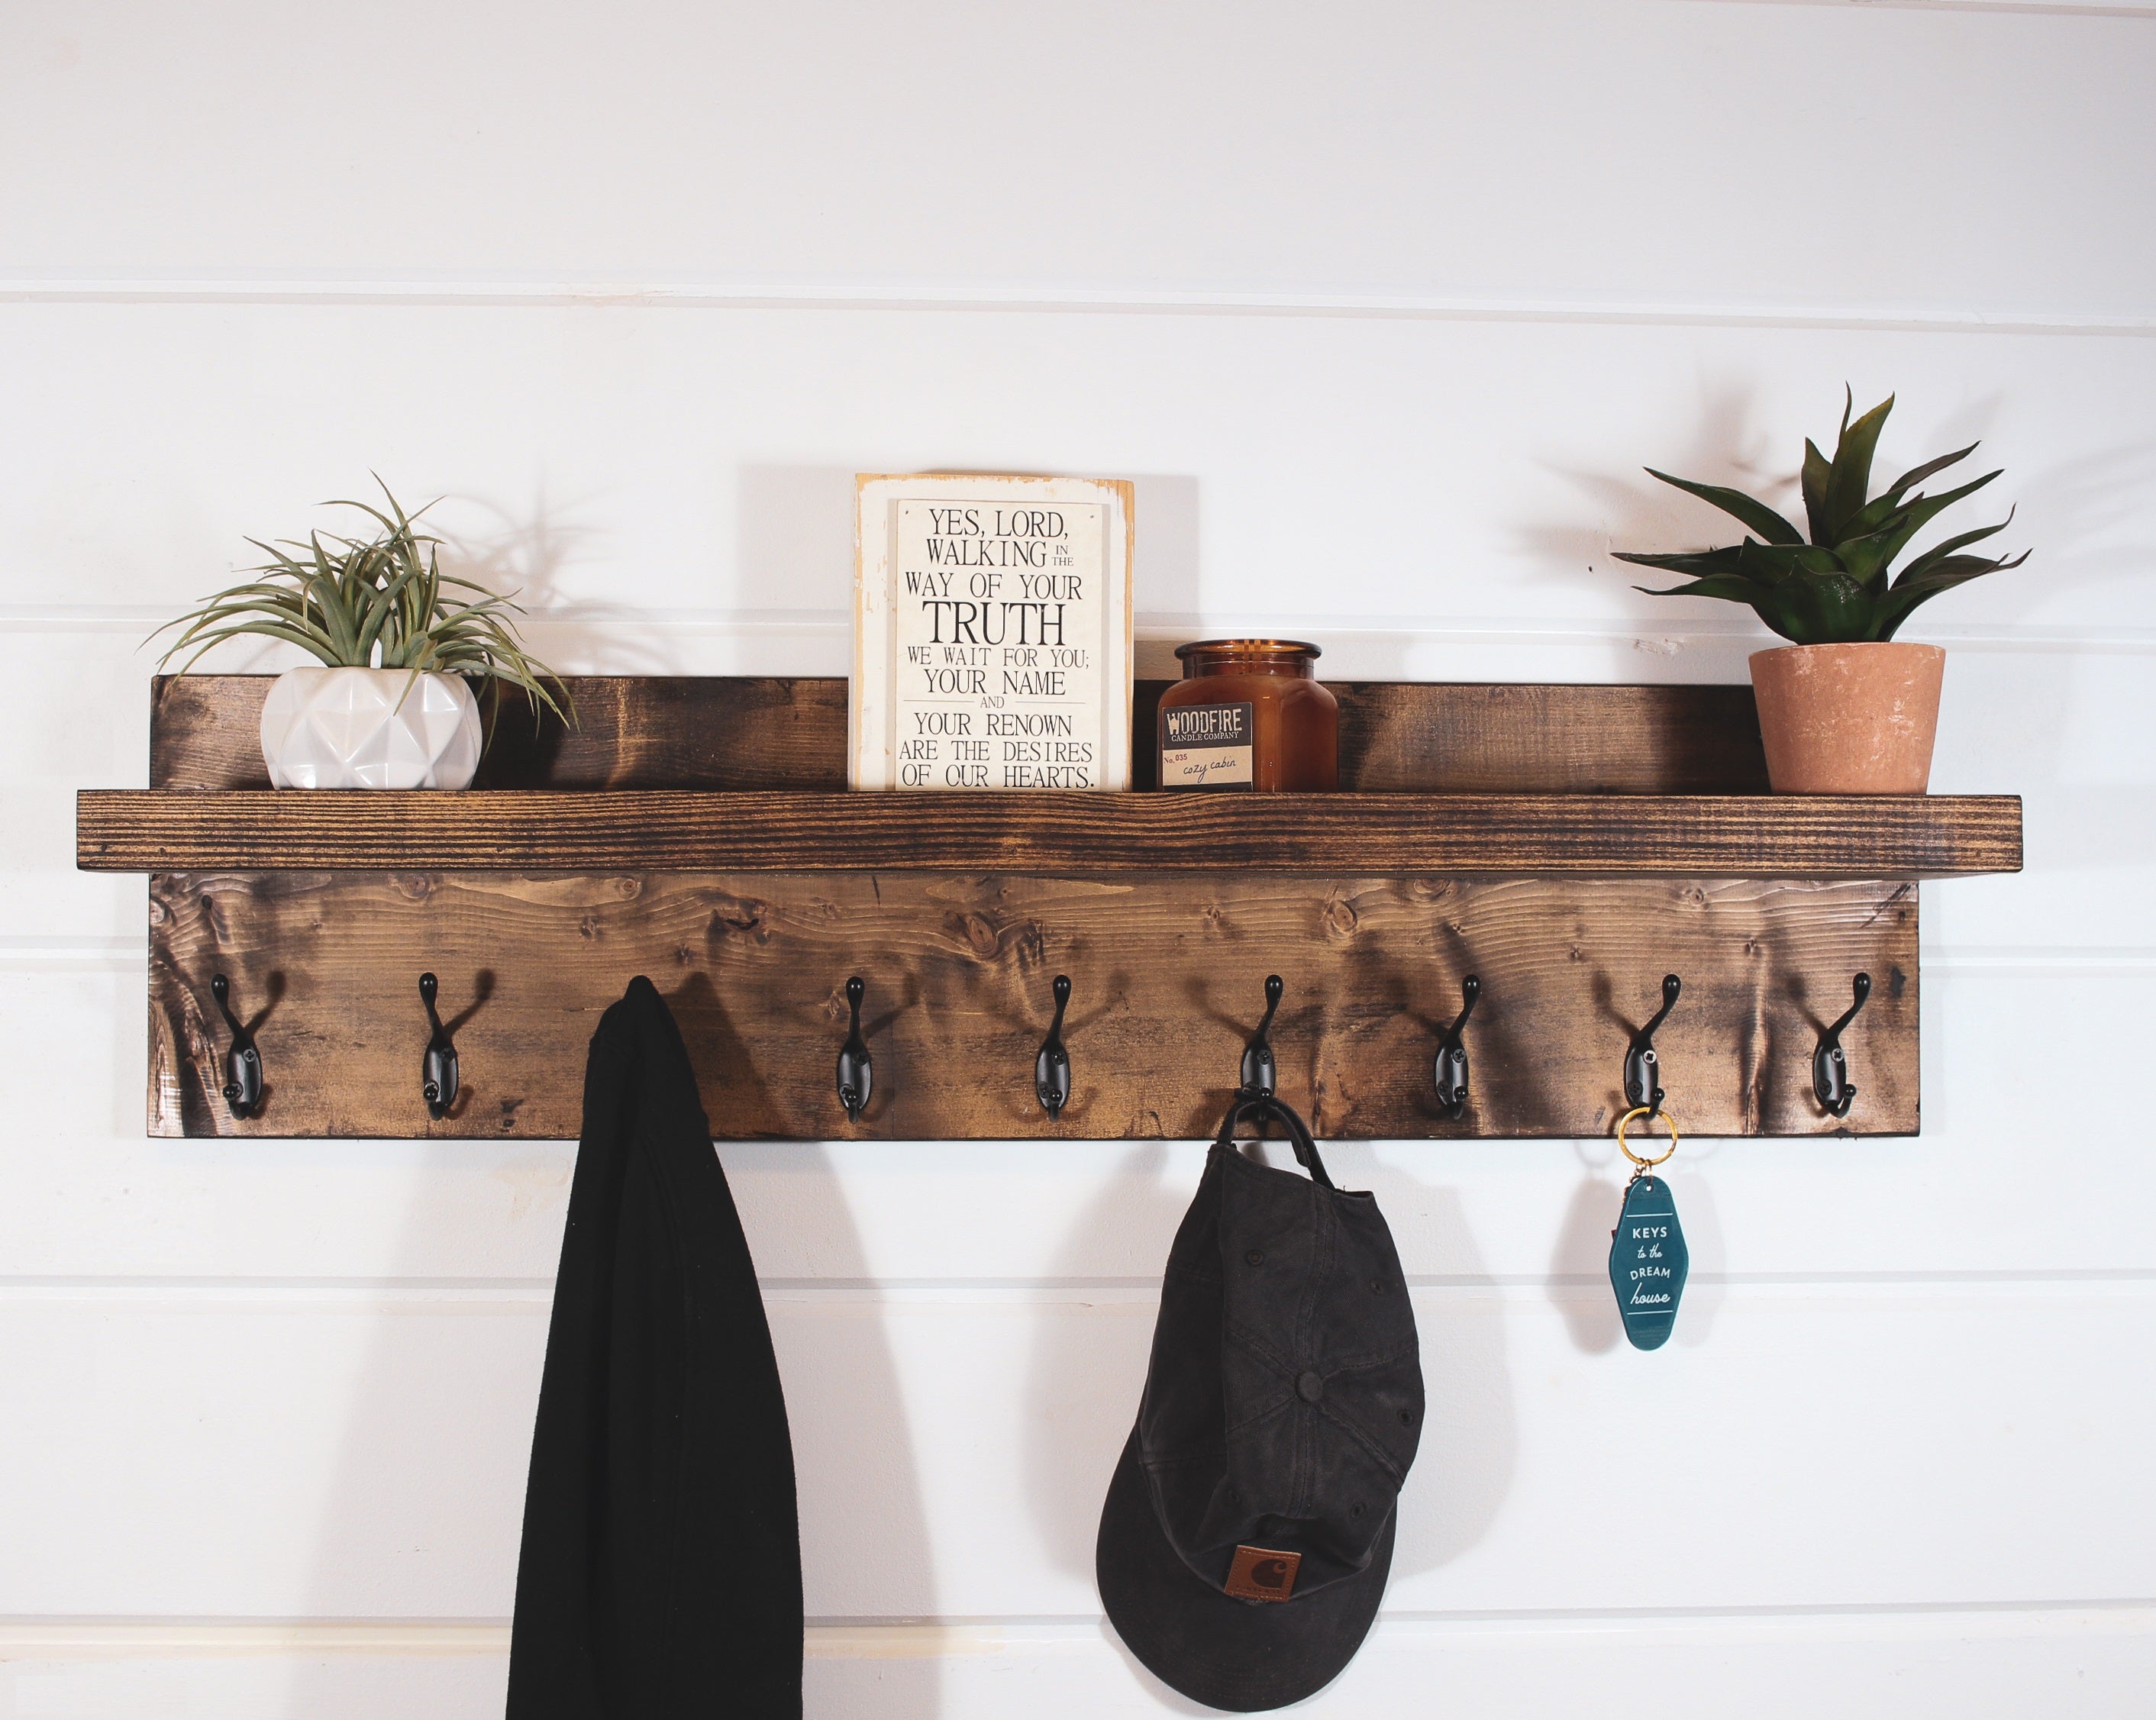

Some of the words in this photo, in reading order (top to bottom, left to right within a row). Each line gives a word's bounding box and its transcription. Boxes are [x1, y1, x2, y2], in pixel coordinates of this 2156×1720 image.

[928, 508, 985, 536] YES,
[995, 510, 1068, 539] LORD,
[927, 539, 1047, 568] WALKING
[1051, 557, 1074, 566] THE
[1055, 545, 1068, 554] IN
[905, 572, 954, 596] WAY
[970, 573, 1002, 598] OF
[1019, 575, 1083, 600] YOUR
[922, 600, 1067, 646] TRUTH
[908, 646, 931, 665] WE
[944, 647, 991, 666] WAIT
[1002, 648, 1038, 667] FOR
[1051, 649, 1089, 670] YOU;
[923, 669, 986, 694] YOUR
[1002, 671, 1066, 695] NAME
[980, 696, 1005, 708] AND
[914, 712, 972, 735] YOUR
[986, 714, 1072, 736] RENOWN
[1167, 708, 1242, 734] WOODFIRE
[1172, 734, 1202, 742] CANDLE
[1204, 731, 1238, 741] COMPANY
[899, 740, 938, 760] ARE
[951, 741, 990, 761] THE
[1003, 742, 1093, 762] DESIRES
[902, 763, 931, 786] OF
[945, 765, 989, 787] OUR
[1002, 766, 1095, 789] HEARTS.
[1183, 765, 1208, 783] cozy
[1210, 756, 1237, 769] cabin
[1632, 1227, 1667, 1238] KEYS
[1638, 1245, 1647, 1259] to
[1650, 1243, 1663, 1258] the
[1630, 1267, 1670, 1280] DREAM
[1630, 1282, 1670, 1305] house
